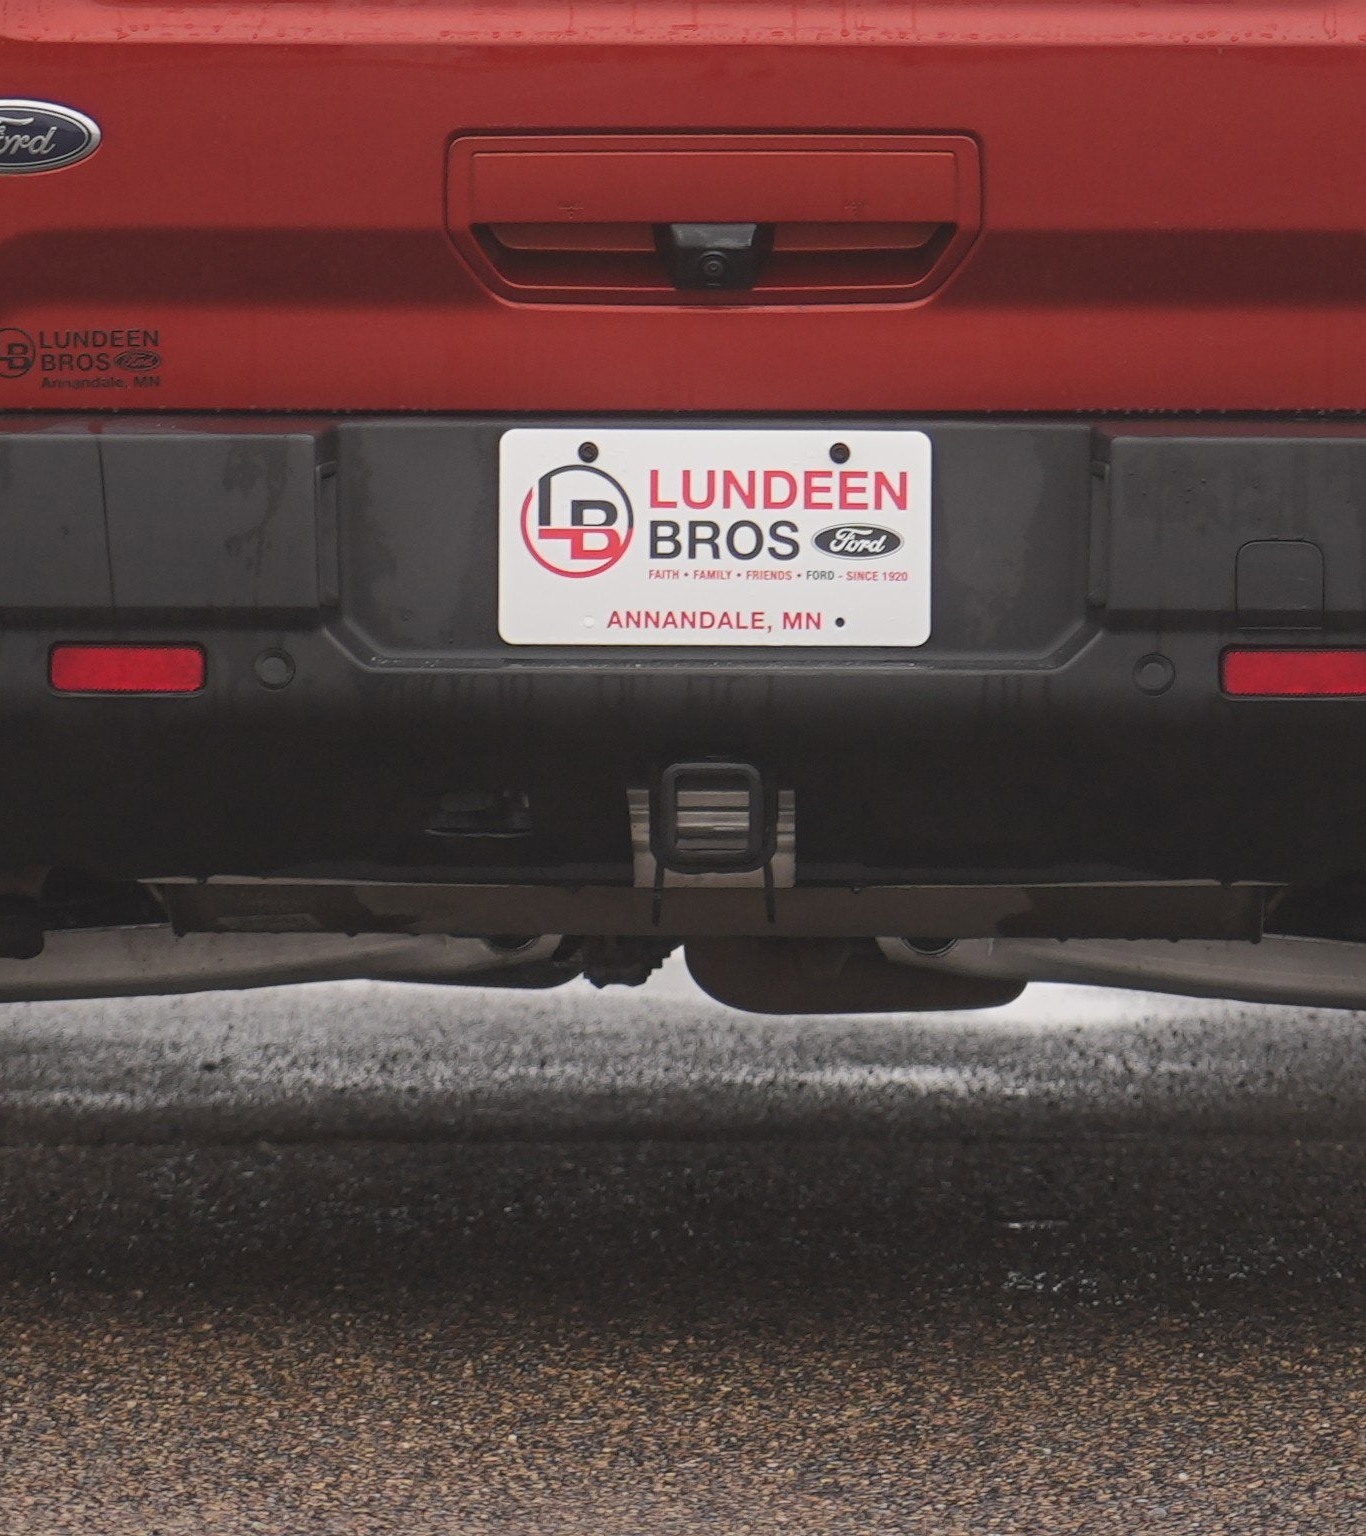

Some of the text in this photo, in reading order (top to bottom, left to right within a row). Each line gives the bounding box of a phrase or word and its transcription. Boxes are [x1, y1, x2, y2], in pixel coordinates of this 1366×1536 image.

[39, 330, 159, 348] LUNDEEN
[41, 353, 110, 371] BROS
[133, 376, 160, 387] MN
[649, 469, 909, 511] LUNDEEN
[649, 520, 800, 560] BROS
[829, 527, 887, 553] Ford
[648, 569, 909, 582] FAITH FAMILY FRIENDS FORD SINCE 1920
[606, 611, 822, 633] ANNANDALE, MN
